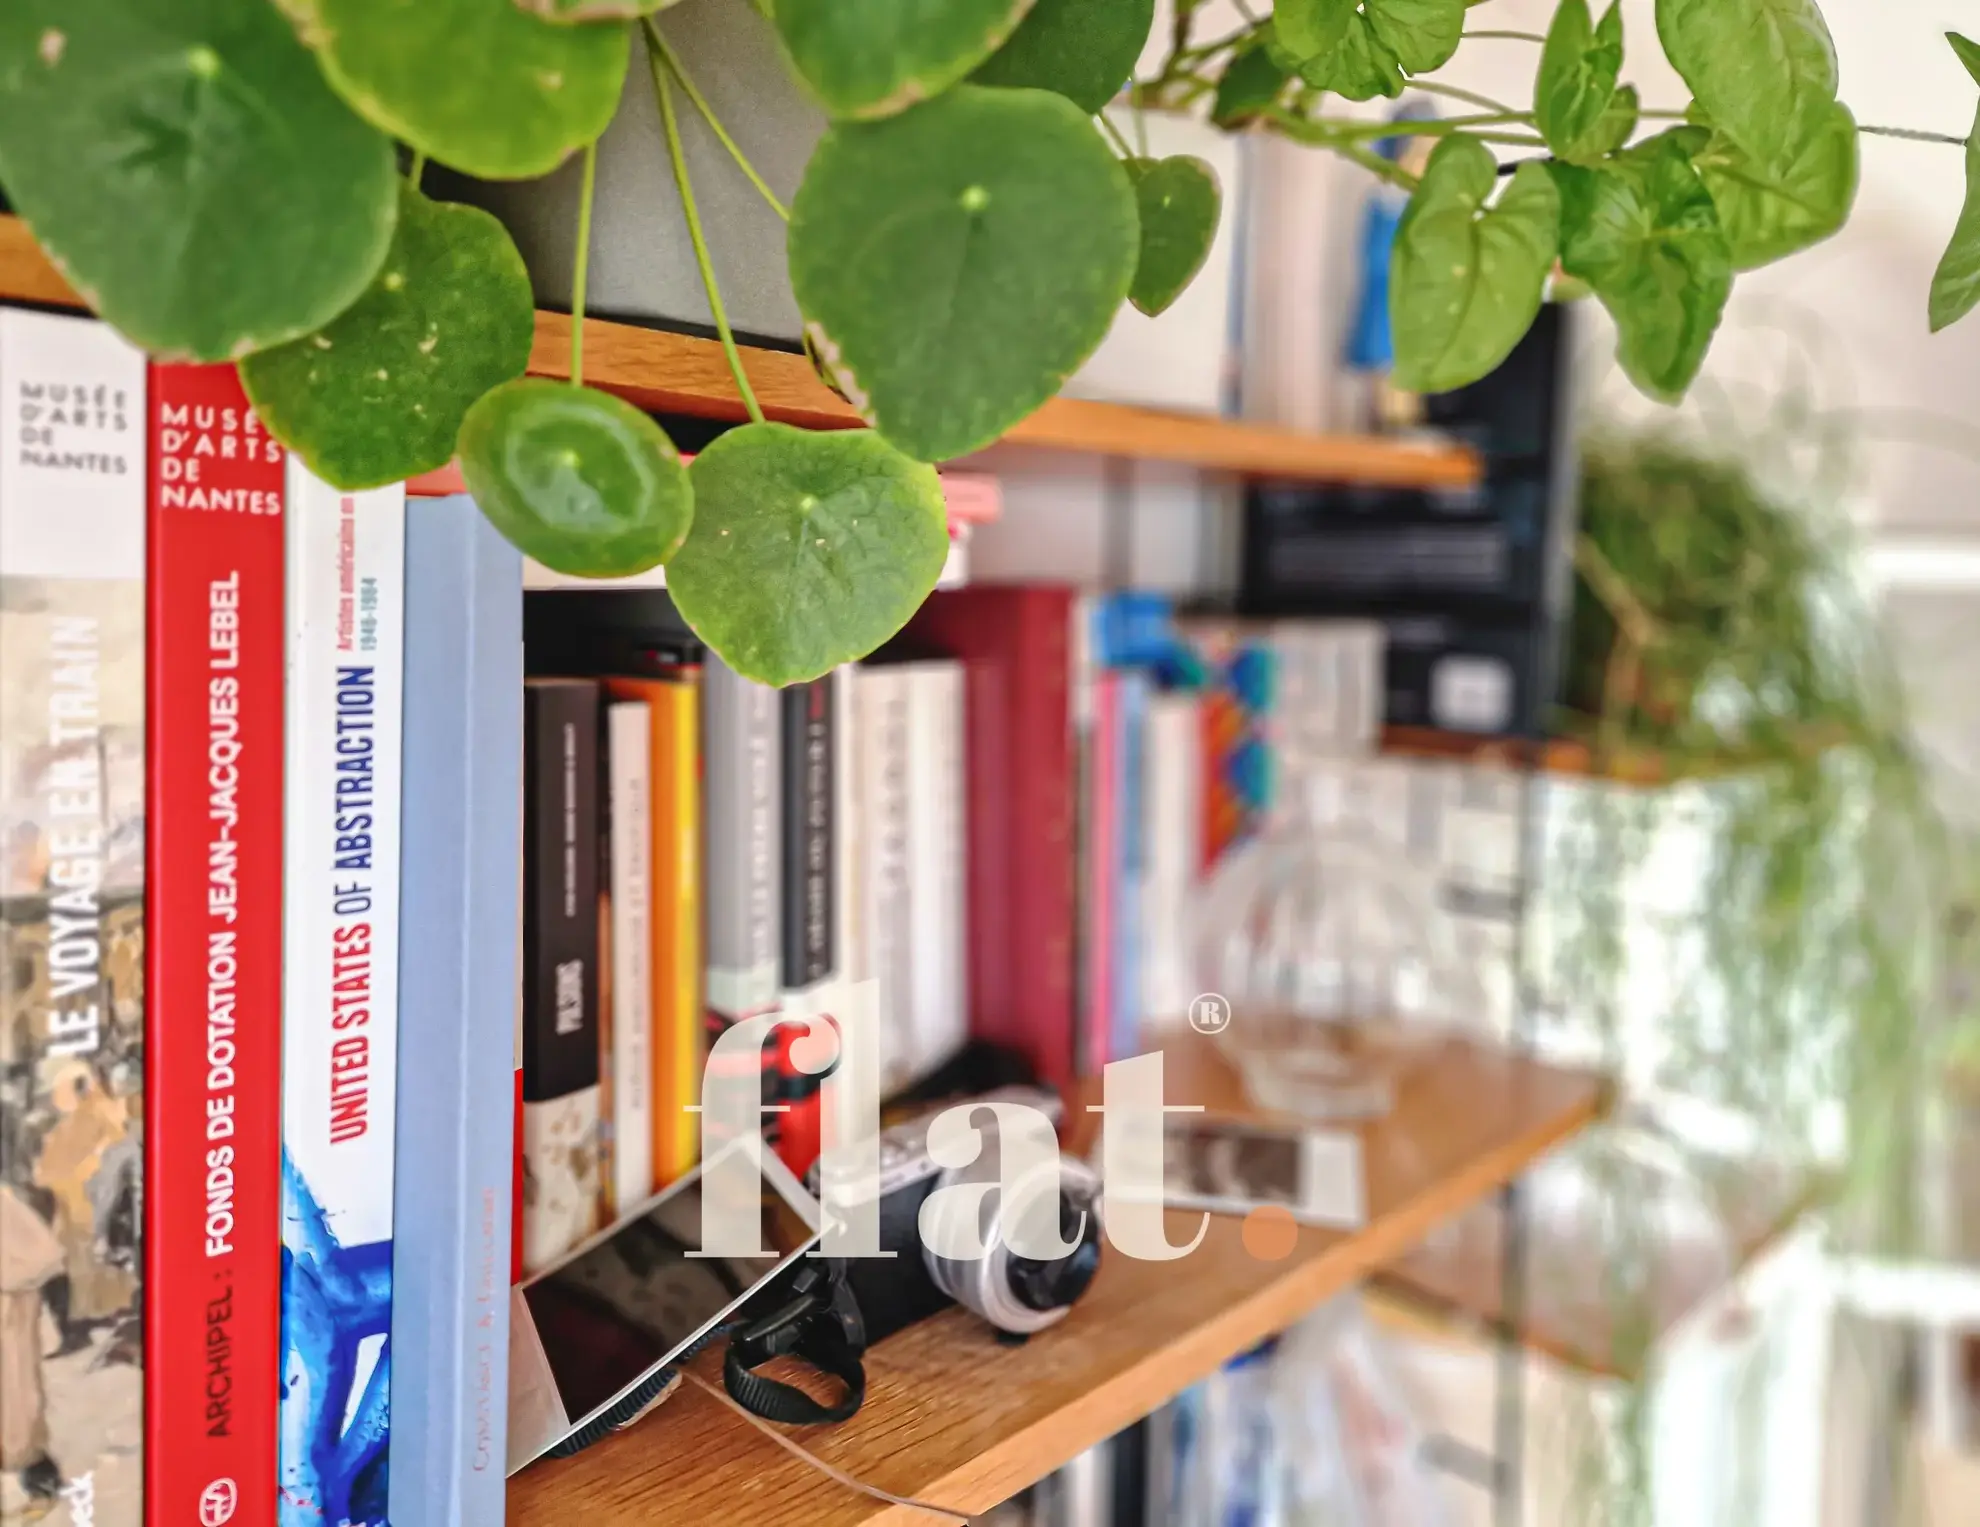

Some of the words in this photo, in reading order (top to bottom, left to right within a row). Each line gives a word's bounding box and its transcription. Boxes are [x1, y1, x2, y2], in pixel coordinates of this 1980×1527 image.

[19, 425, 54, 446] DE
[19, 449, 128, 475] NANTES
[161, 456, 200, 483] DE
[161, 484, 281, 516] NANTES
[208, 569, 240, 669] LEBEL
[47, 614, 98, 747] TRAIN
[48, 757, 98, 817] EN
[208, 676, 240, 924] JEAN-JACQUES
[334, 665, 374, 870] ABSTRACTION
[48, 828, 98, 996] VOYAGE
[333, 879, 371, 916] OF
[206, 931, 236, 1090] DOTATION
[331, 922, 371, 1030] STATES
[48, 1004, 98, 1057] LE
[206, 1094, 235, 1140] DE
[330, 1035, 369, 1144] UNITED
[205, 1144, 235, 1257] FONDS
[206, 1285, 233, 1438] ARCHIPEL
